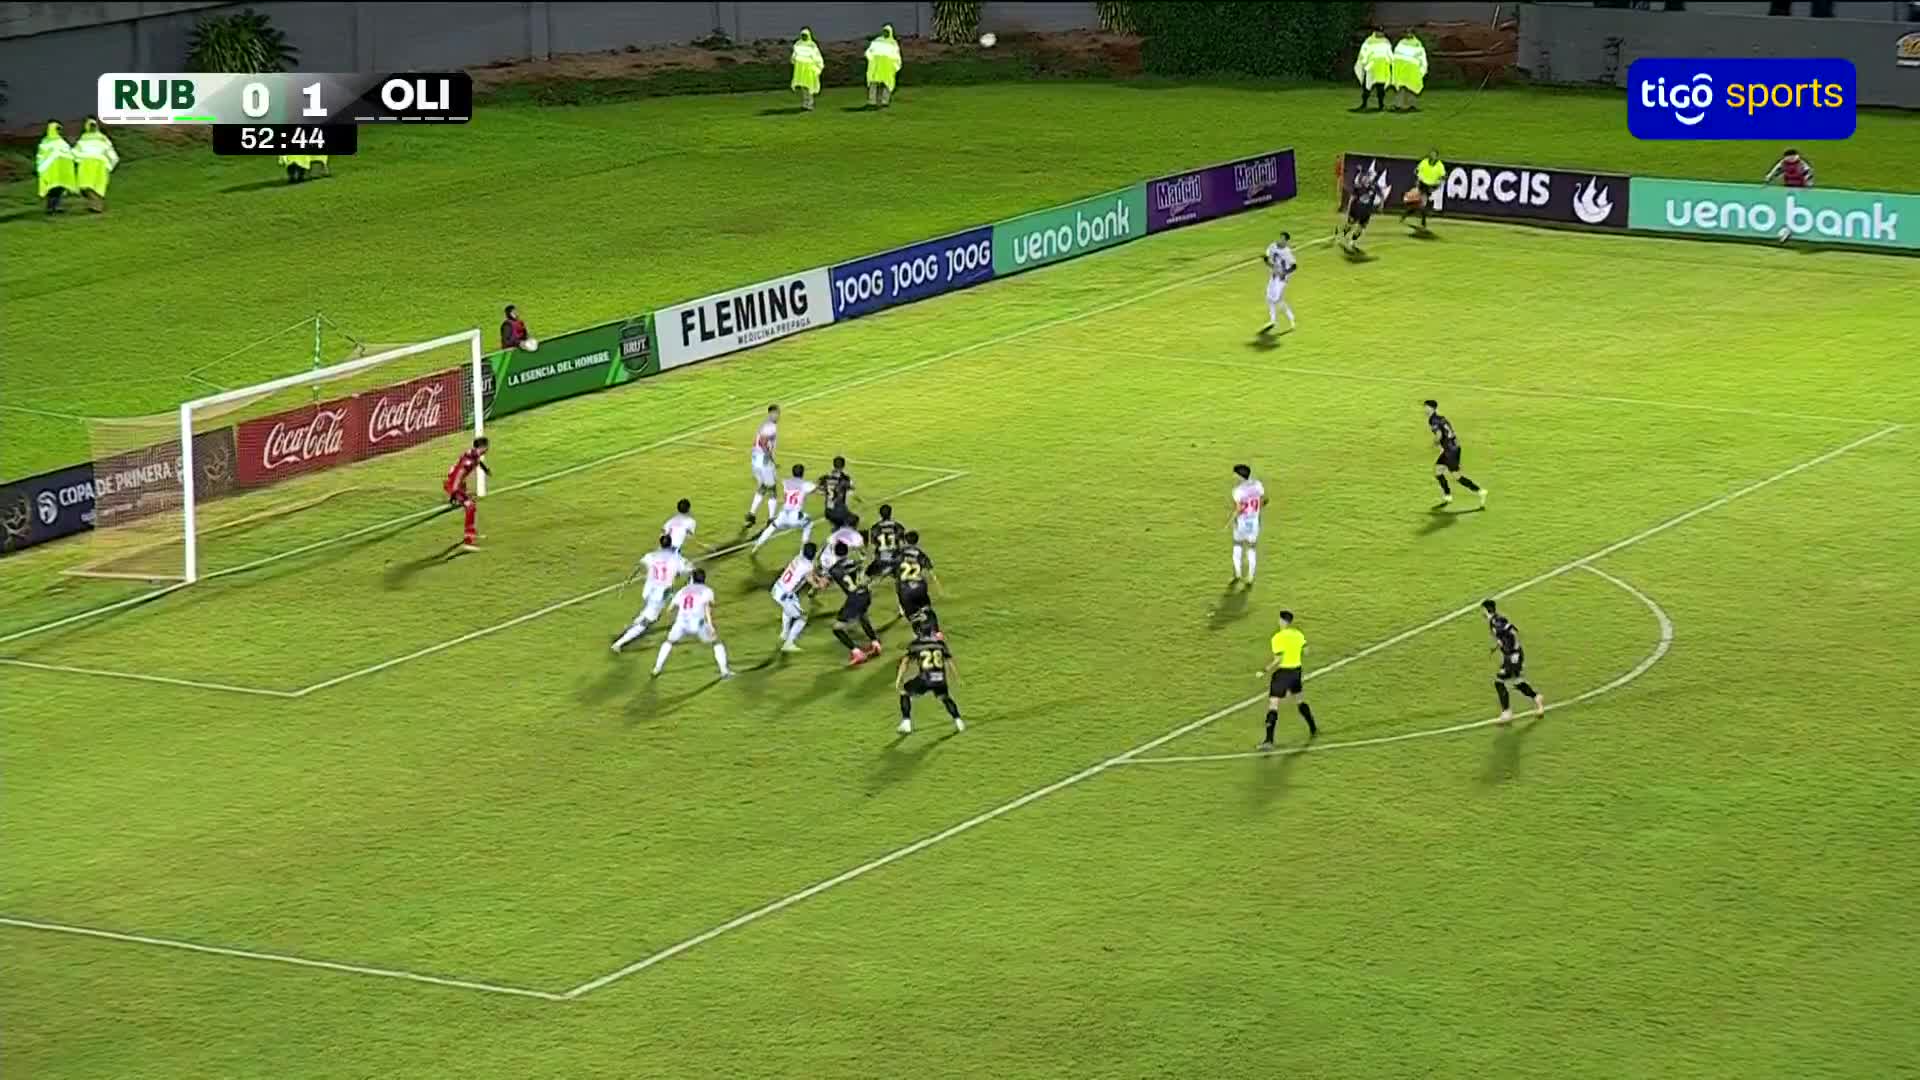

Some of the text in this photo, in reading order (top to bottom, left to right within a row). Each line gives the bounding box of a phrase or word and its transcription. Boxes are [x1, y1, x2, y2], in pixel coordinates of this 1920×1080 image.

[1013, 199, 1130, 264] ueno bank
[1666, 196, 1899, 241] ueno bank
[835, 239, 991, 312] JOOG JOOG JOOG
[680, 279, 809, 347] FLEMING
[507, 350, 611, 387] LA ESENCIA DEL HOMBRE
[622, 337, 648, 355] BRUT
[58, 480, 96, 507] COPA
[95, 475, 115, 496] DE
[115, 461, 173, 492] PRIMERA
[899, 561, 922, 582] 22
[919, 648, 944, 671] 28
